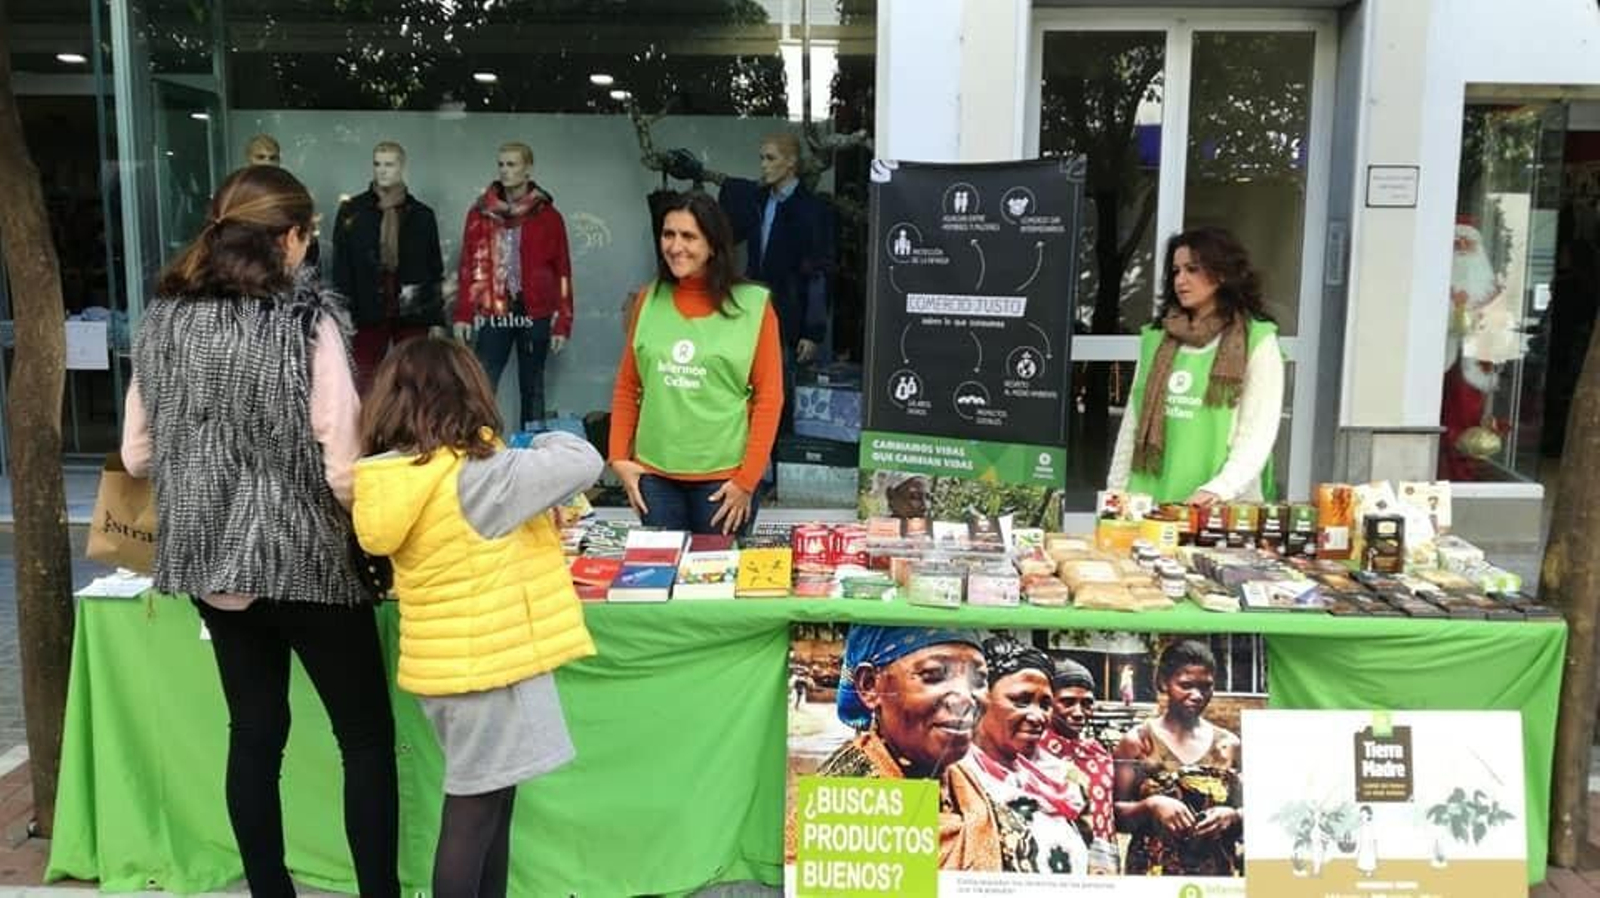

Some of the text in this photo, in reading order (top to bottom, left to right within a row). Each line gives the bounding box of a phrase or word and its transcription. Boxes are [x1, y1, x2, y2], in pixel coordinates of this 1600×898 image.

[908, 295, 1022, 314] COMERCIO JUSTO
[473, 311, 533, 331] ptalos
[872, 439, 965, 457] CAMBIAMOS VIDAS
[871, 451, 974, 471] QUE CAMBIAN VIDAS
[1362, 740, 1403, 759] Tierra
[1362, 759, 1406, 778] Madre
[804, 786, 903, 820] ¿BUSCAS
[803, 822, 935, 854] PRODUCTOS
[802, 860, 904, 890] BUENOS?
